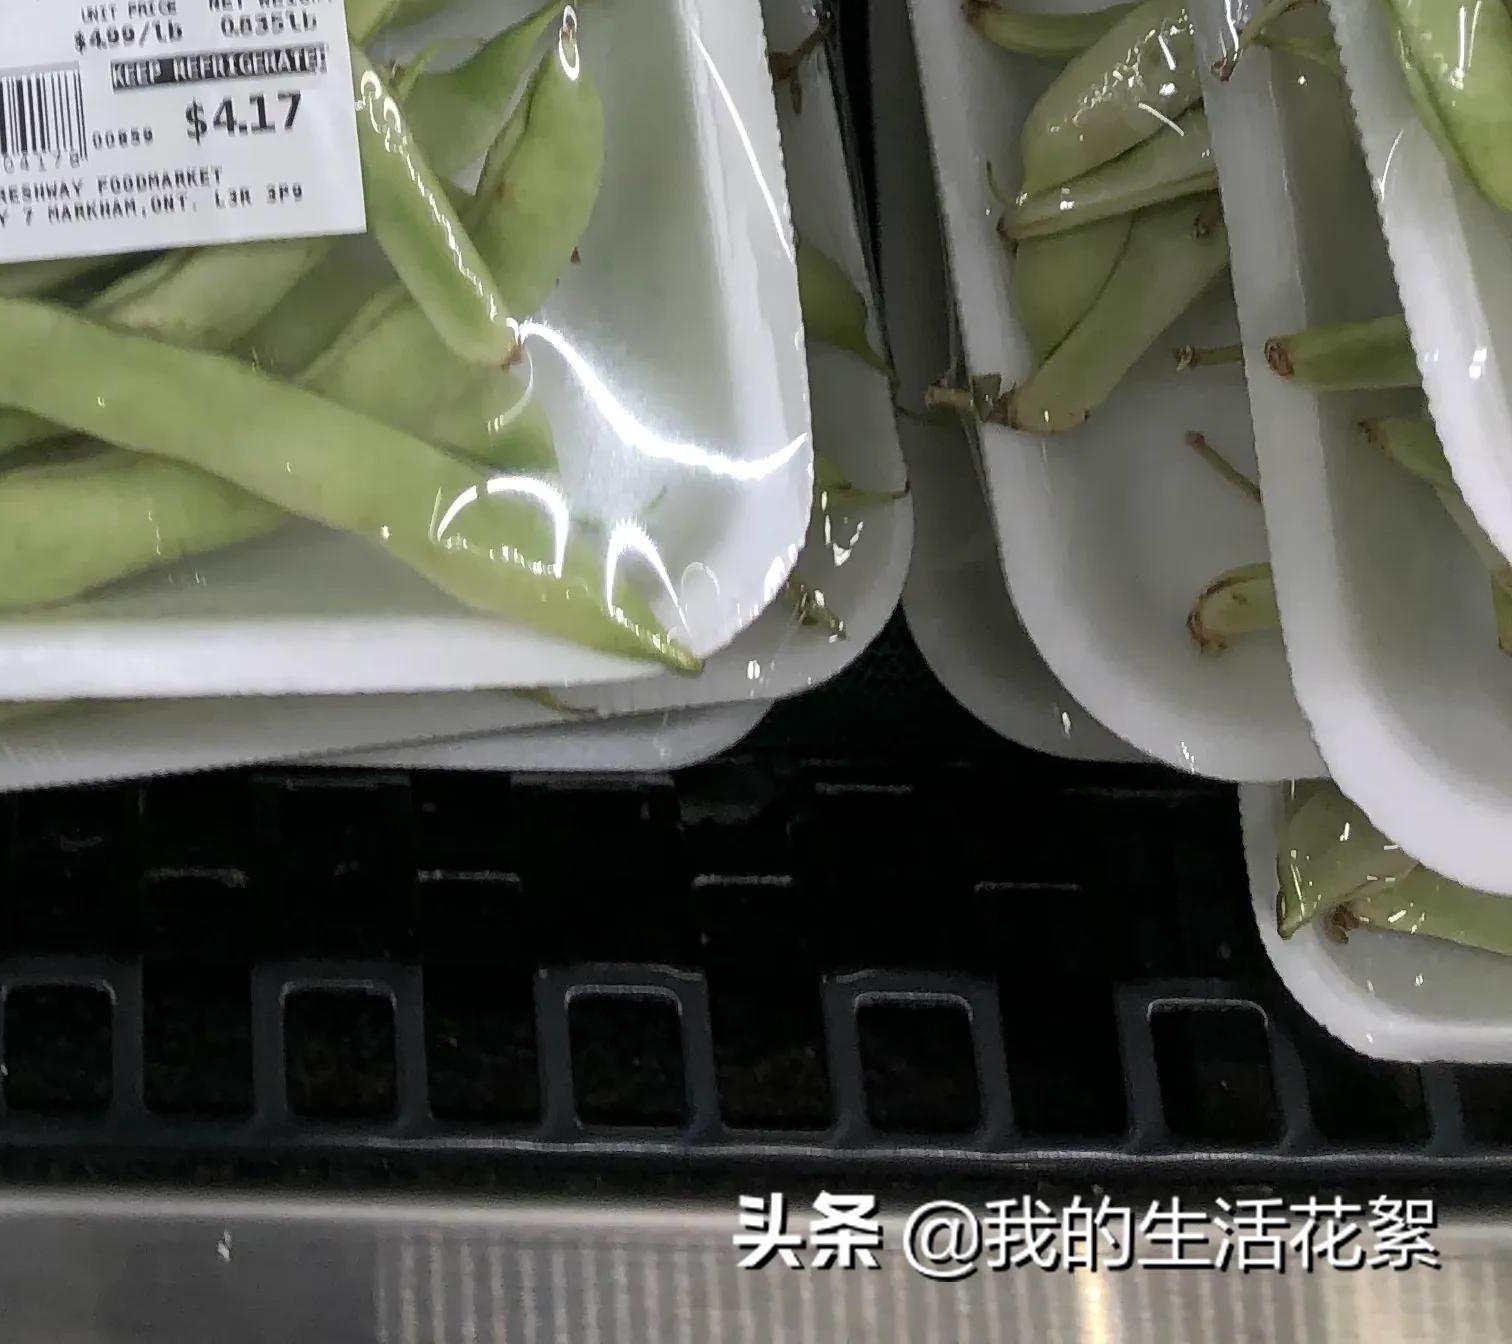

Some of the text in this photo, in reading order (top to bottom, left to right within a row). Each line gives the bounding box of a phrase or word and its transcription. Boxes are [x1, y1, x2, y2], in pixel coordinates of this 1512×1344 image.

[80, 5, 119, 25] UNIT
[111, 60, 163, 89] KEEP
[185, 88, 304, 146] $4.17
[97, 164, 224, 197] FOODMARKET
[24, 208, 34, 227] 7
[214, 187, 252, 209] L3R
